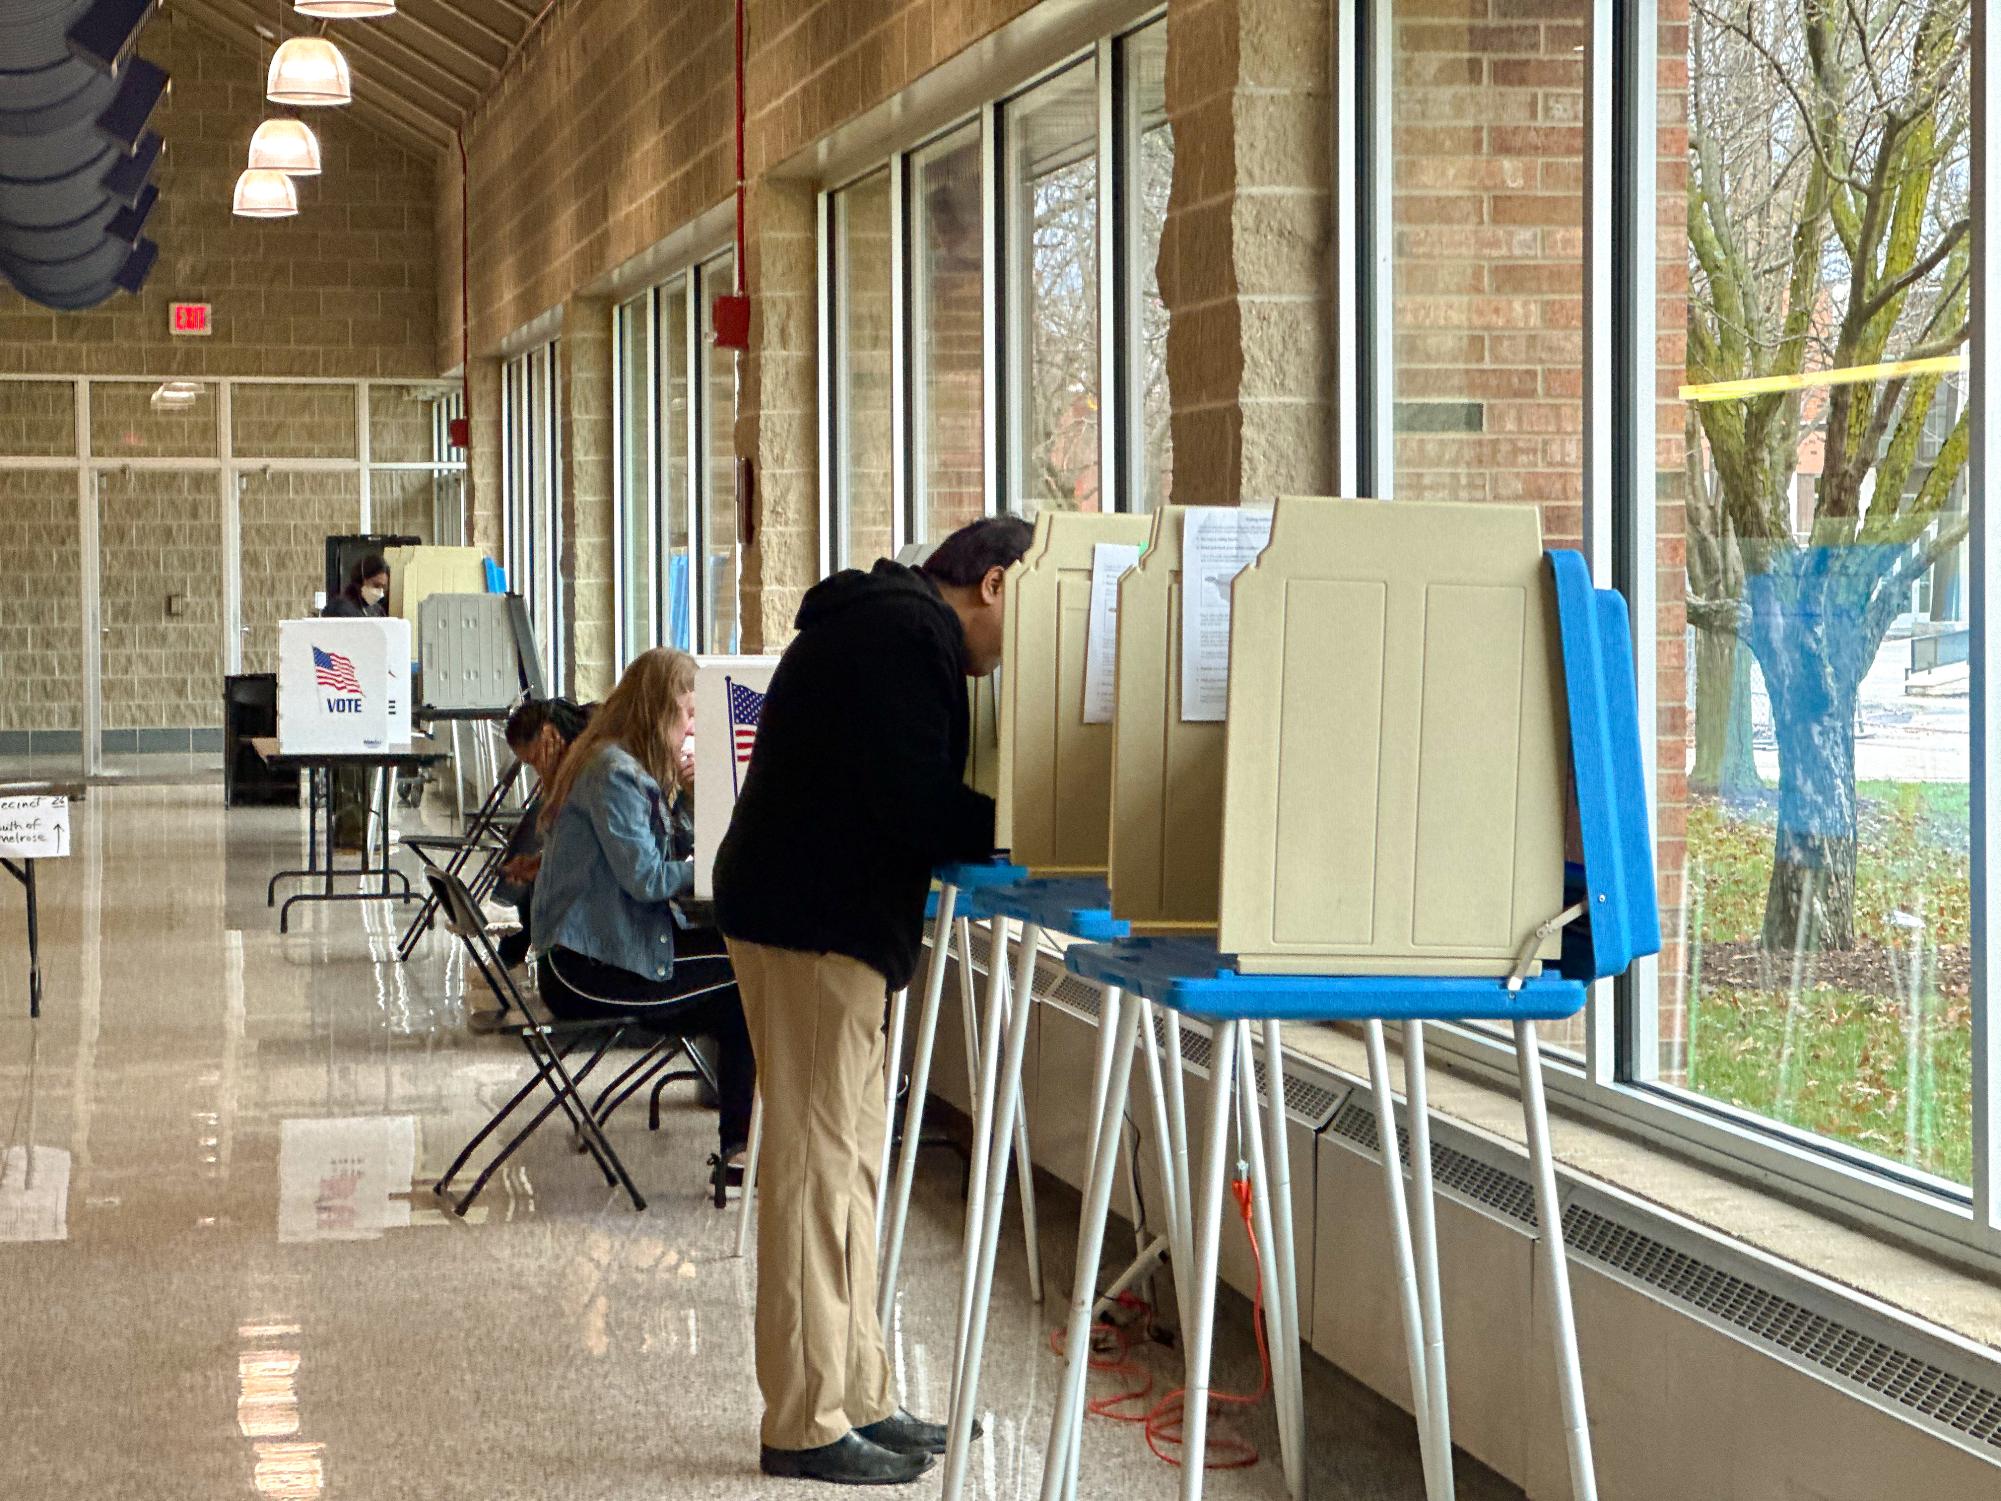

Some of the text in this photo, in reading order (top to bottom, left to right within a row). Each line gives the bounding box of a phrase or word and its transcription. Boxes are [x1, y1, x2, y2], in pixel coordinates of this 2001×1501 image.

[176, 306, 206, 330] EXIT
[327, 698, 362, 713] VOTE
[26, 818, 41, 830] of
